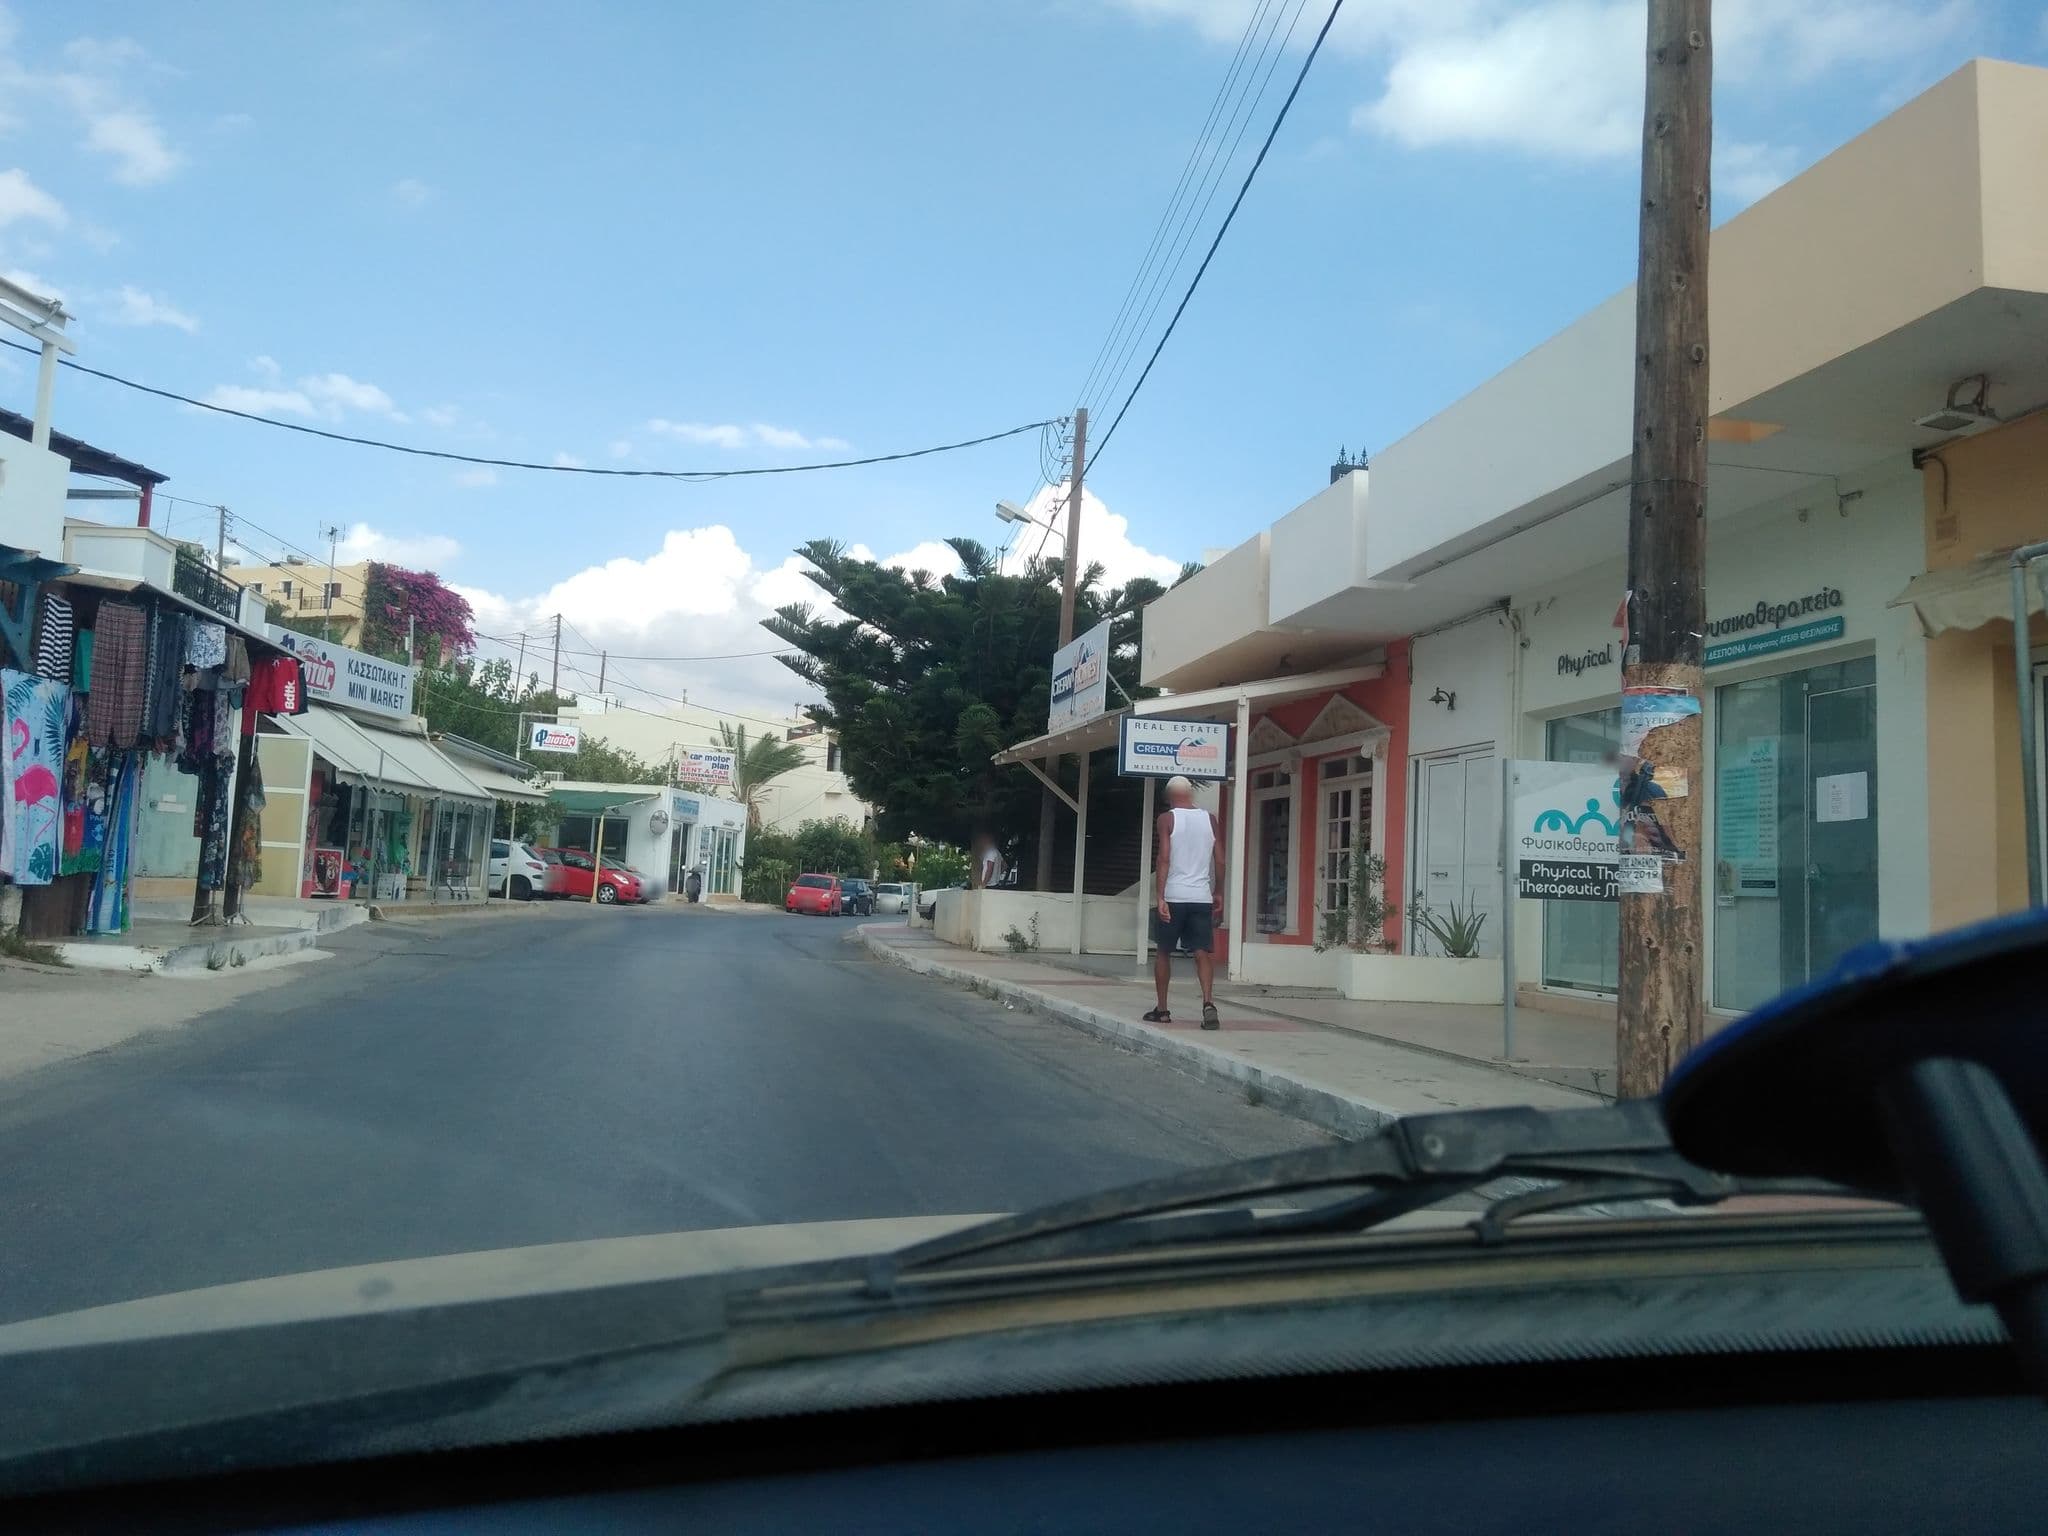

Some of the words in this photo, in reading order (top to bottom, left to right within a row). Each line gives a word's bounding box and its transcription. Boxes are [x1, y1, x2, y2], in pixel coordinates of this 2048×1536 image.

[1557, 642, 1612, 677] Physical
[1708, 644, 1746, 660] ΔΕΣΠΟΙΝΑ
[347, 657, 398, 688] ΚΑΣΣΩΤΑΚΗ
[400, 674, 408, 690] Γ.
[348, 681, 368, 701] MINI
[370, 690, 405, 711] MARKET
[1134, 722, 1165, 731] REAL
[1173, 723, 1220, 734] ESTATE
[690, 753, 703, 761] car
[705, 754, 731, 763] motor
[1136, 744, 1174, 754] CRETAN
[711, 762, 730, 770] plan
[1531, 862, 1593, 882] Physical
[1519, 878, 1601, 898] Therapeutic
